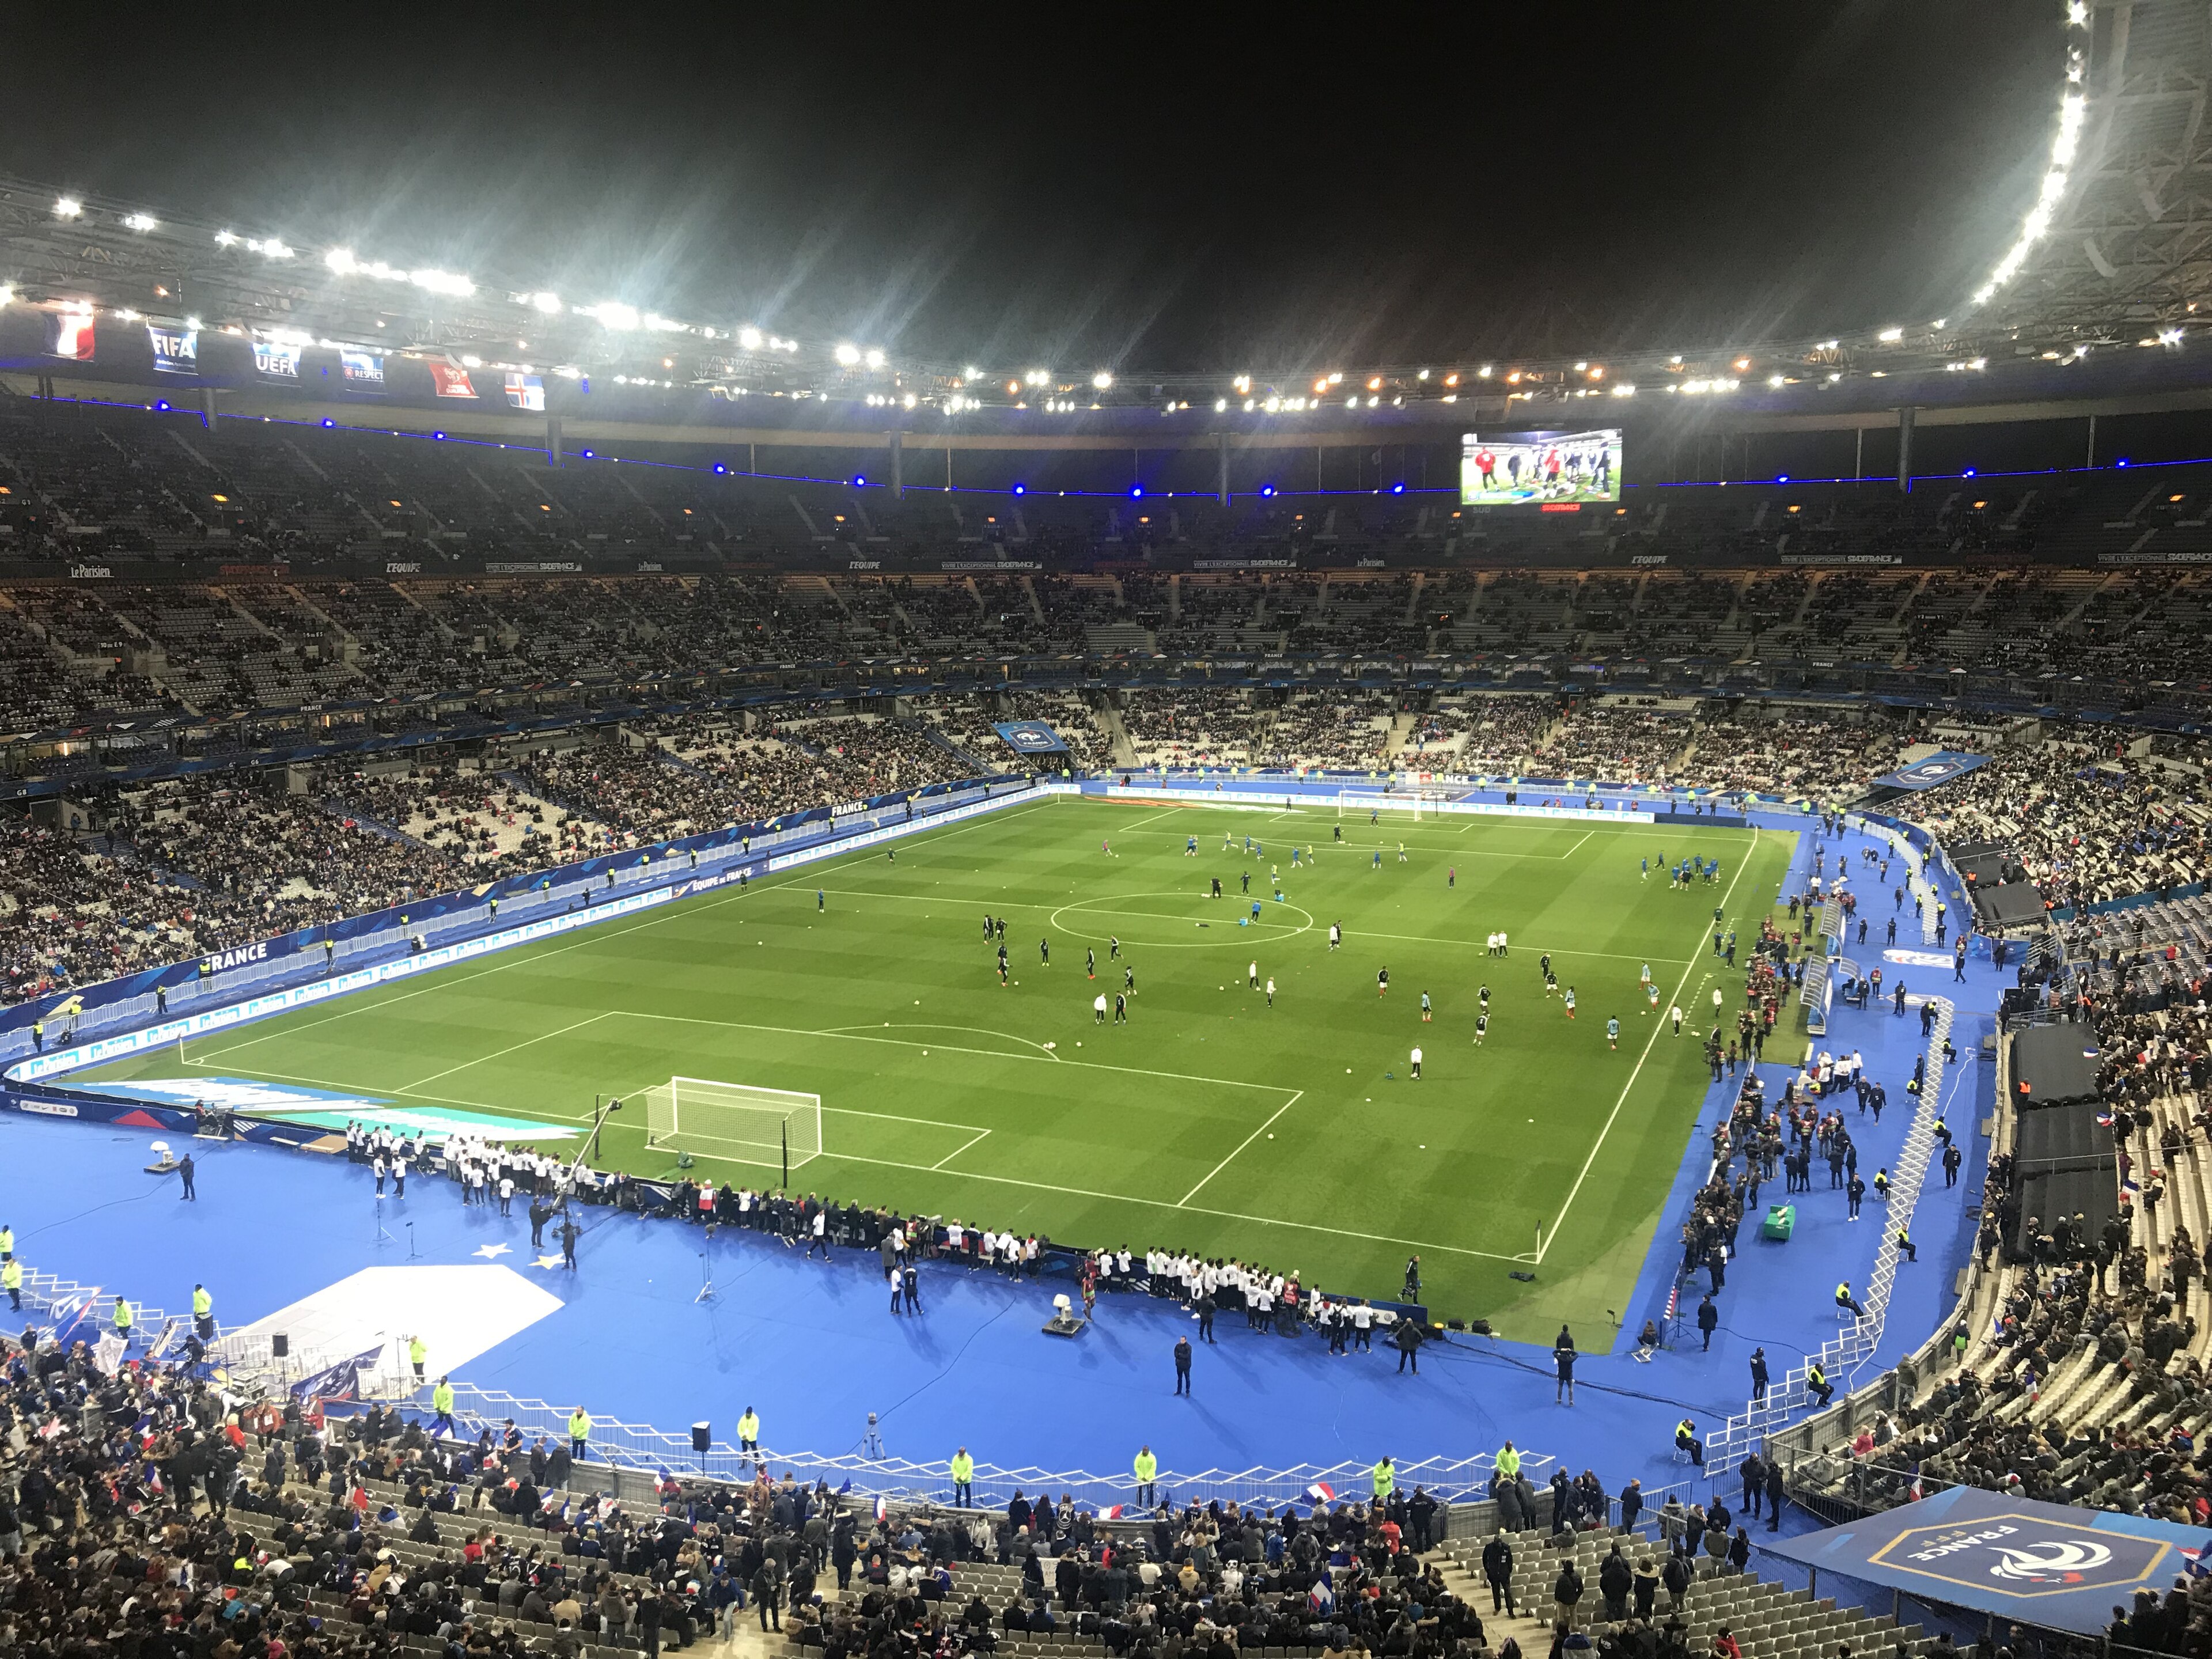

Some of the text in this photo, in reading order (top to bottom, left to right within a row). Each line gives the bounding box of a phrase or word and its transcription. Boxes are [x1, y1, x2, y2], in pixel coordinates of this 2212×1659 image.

[154, 335, 196, 359] FIFA
[256, 354, 297, 375] UEFA
[354, 369, 383, 380] RESPECT
[831, 801, 863, 817] FRANCE
[693, 876, 718, 891] ÉQUIPE
[726, 867, 752, 882] FRANCE
[654, 1521, 663, 1532] 7
[1907, 1525, 2019, 1561] FRANCE
[1921, 1530, 1967, 1547] FFF
[685, 1604, 692, 1613] 7
